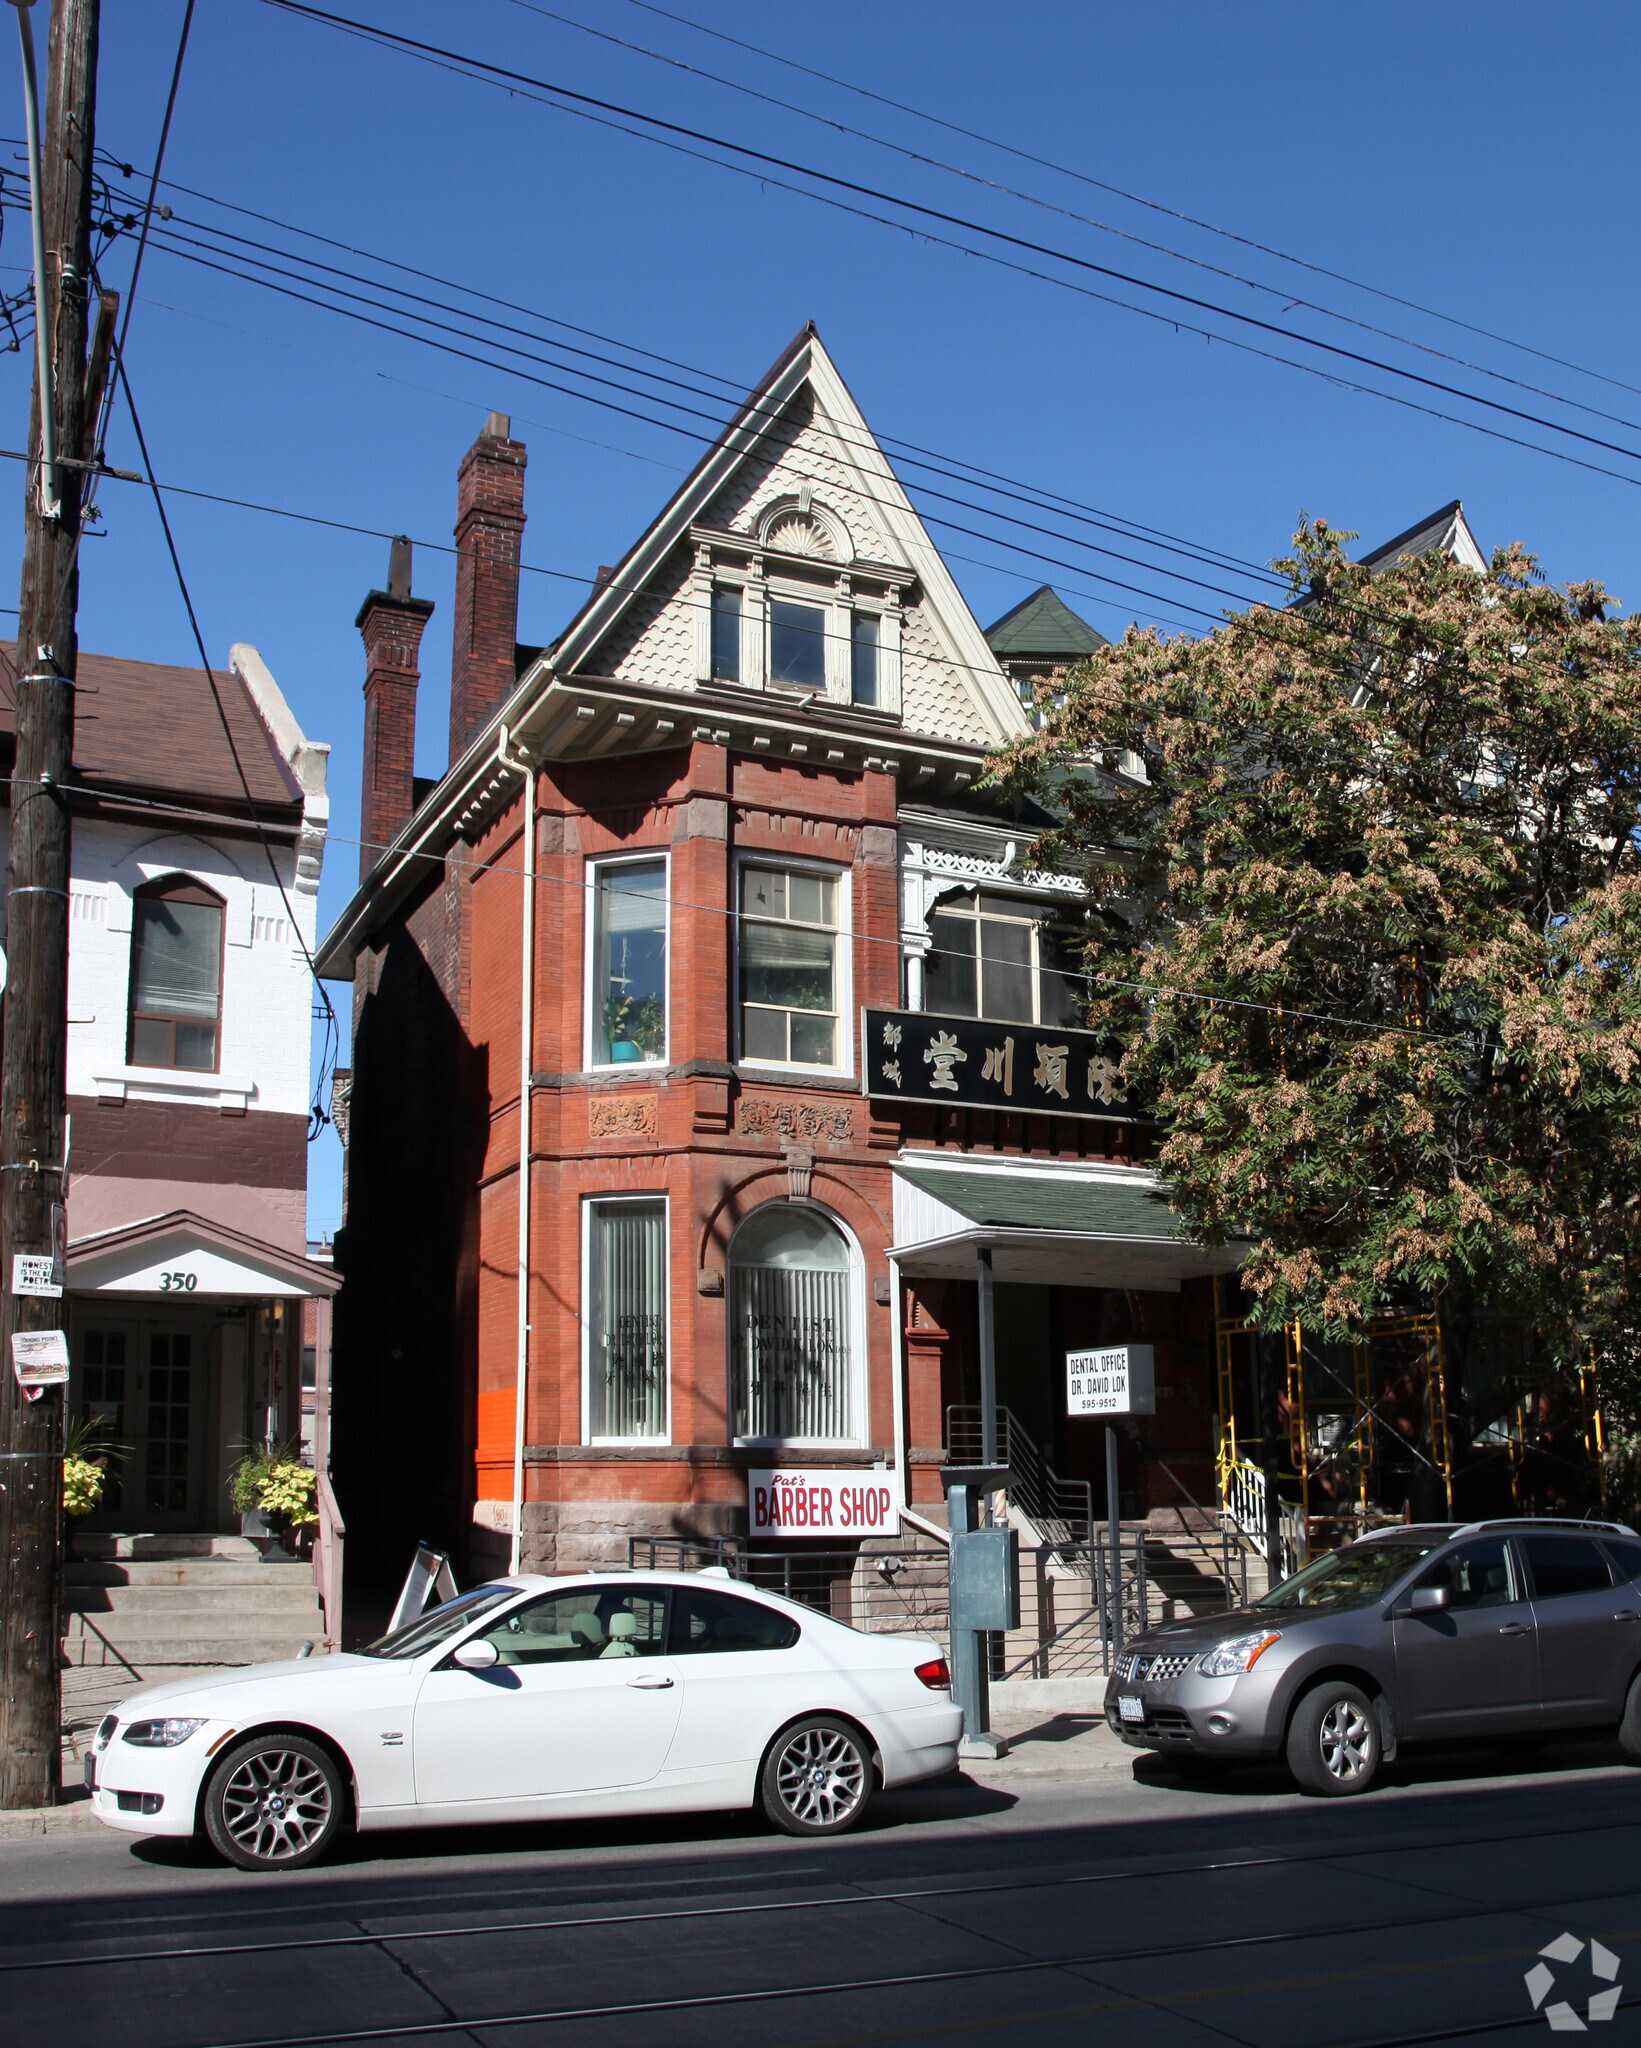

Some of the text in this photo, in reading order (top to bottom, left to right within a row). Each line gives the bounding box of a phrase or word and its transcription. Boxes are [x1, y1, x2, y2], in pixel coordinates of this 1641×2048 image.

[22, 1260, 53, 1270] HONEST
[23, 1276, 49, 1285] POETR
[158, 1272, 198, 1291] 350
[619, 1314, 661, 1328] DENTIST
[746, 1314, 833, 1332] DENTIST
[752, 1336, 791, 1352] DAVID
[808, 1339, 835, 1354] LOK
[1070, 1353, 1126, 1375] DENTAL OFFICE
[1071, 1375, 1126, 1395] DR. DAVID LOK
[1081, 1398, 1117, 1409] 595-9512
[772, 1474, 806, 1486] Pat's
[754, 1487, 891, 1527] BARBER SHOP
